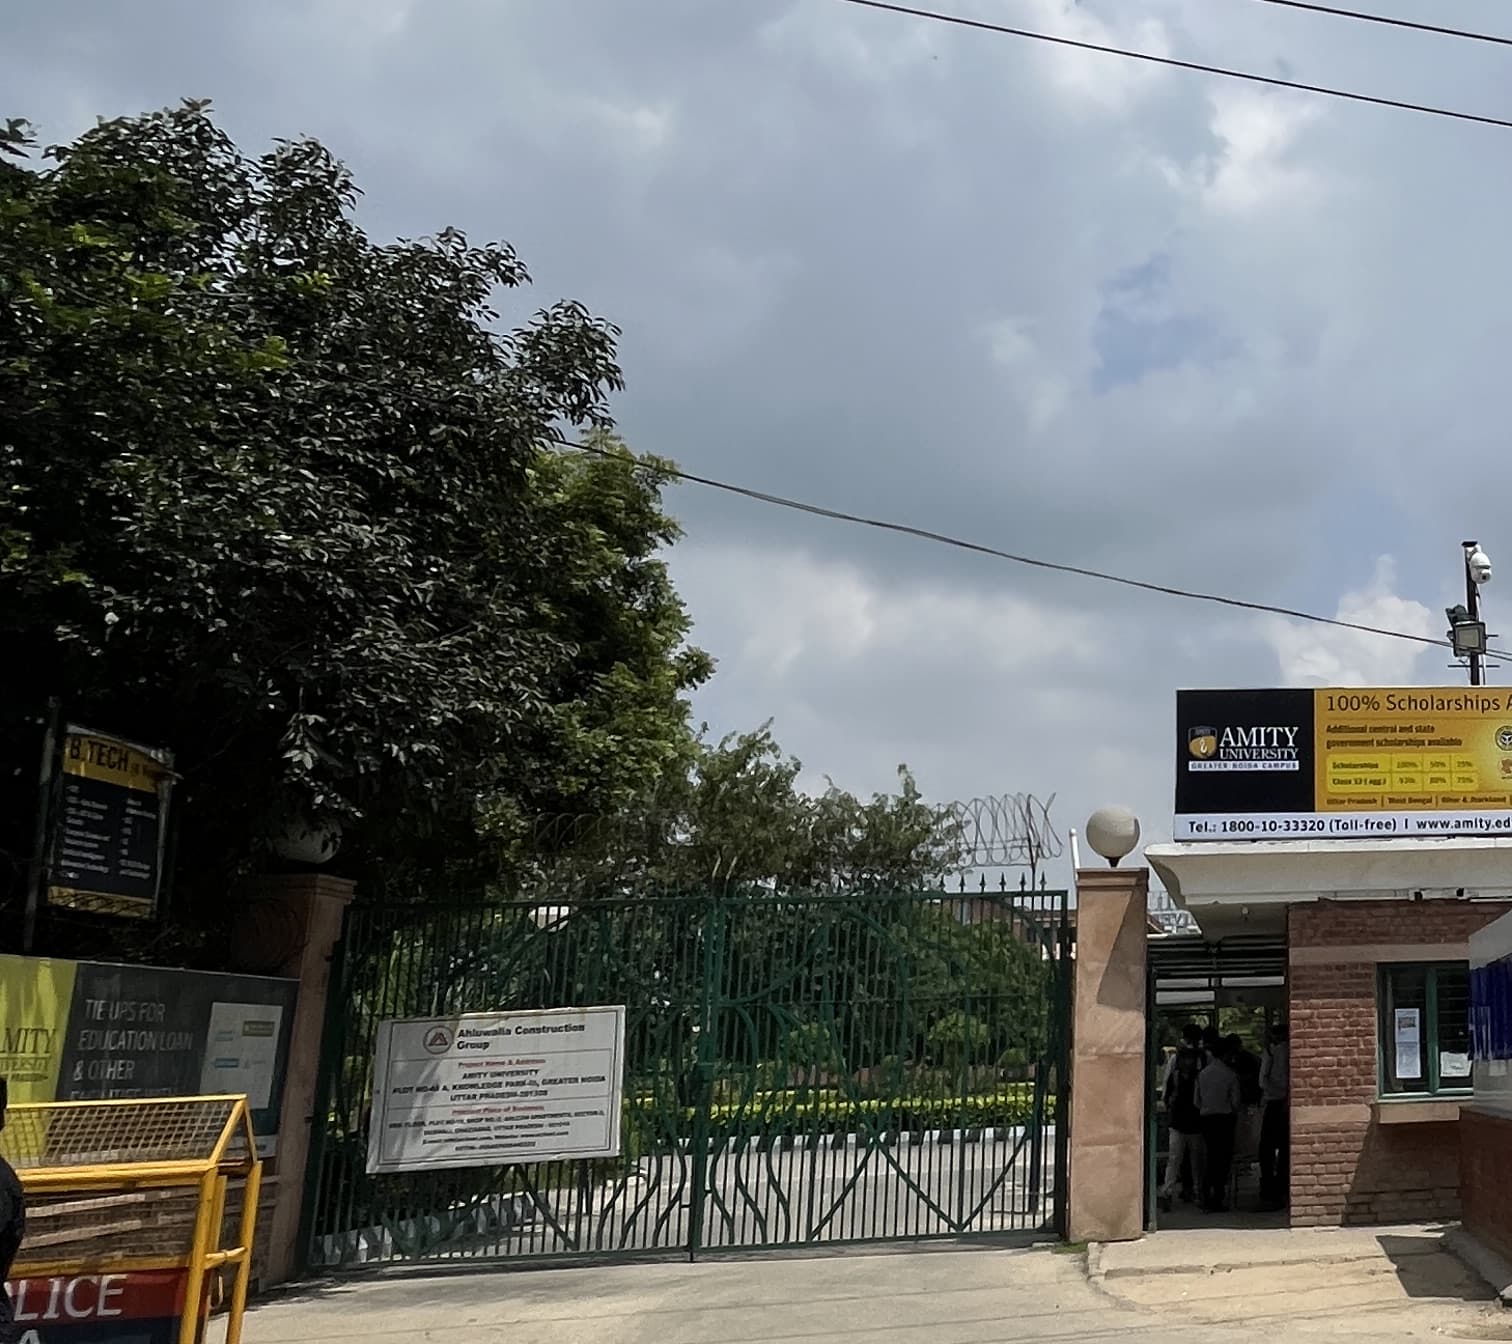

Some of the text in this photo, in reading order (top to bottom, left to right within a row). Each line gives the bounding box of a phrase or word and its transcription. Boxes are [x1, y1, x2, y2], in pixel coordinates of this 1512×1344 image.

[1327, 695, 1380, 712] 100%
[1386, 694, 1500, 714] Scholarships
[1220, 727, 1299, 747] AMITY
[1220, 748, 1299, 760] UNIVERSITY
[1188, 820, 1217, 832] Tel.:
[1221, 820, 1325, 832] 1800-10-33320
[1329, 818, 1397, 832] (Toll-free)
[515, 1023, 585, 1035] Construction
[0, 1027, 56, 1053] MITY
[78, 1029, 157, 1051] EDUCATION
[159, 1031, 195, 1052] LOAN
[456, 1040, 490, 1051] Group
[87, 1059, 136, 1081] OTHER
[4, 1273, 129, 1322] LICE
